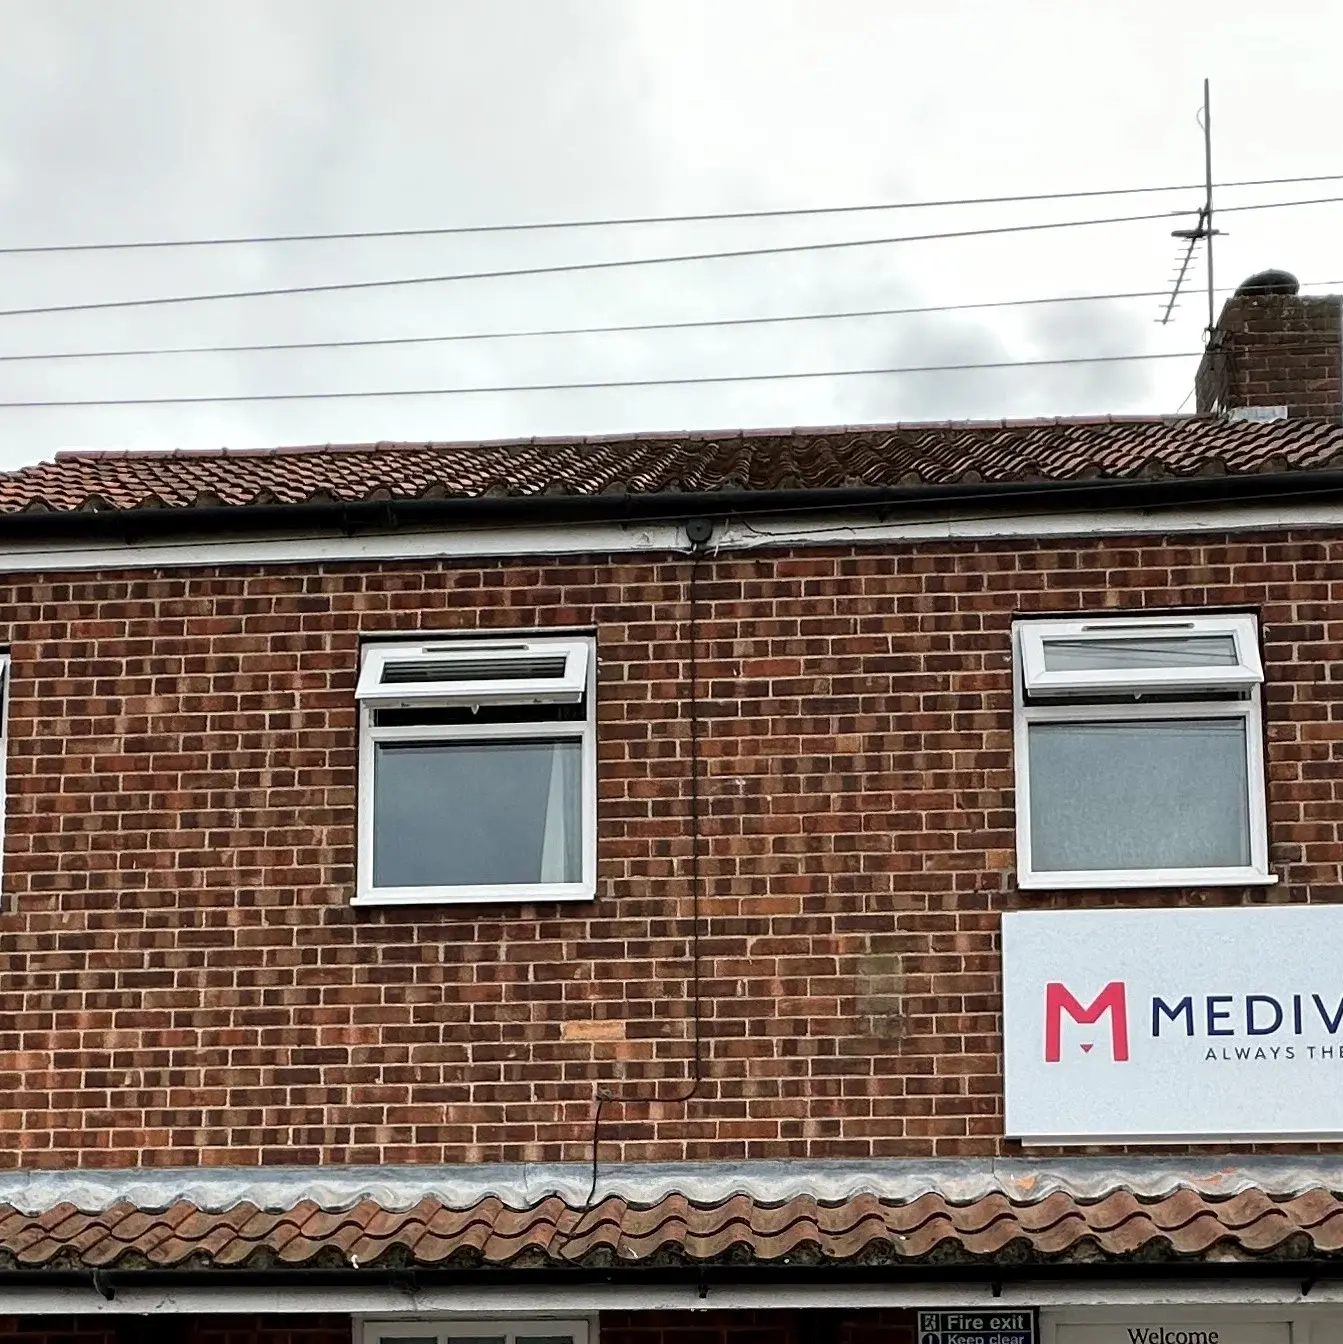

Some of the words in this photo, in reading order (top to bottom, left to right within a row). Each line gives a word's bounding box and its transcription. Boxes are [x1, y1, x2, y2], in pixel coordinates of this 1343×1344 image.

[1045, 981, 1130, 1062] M
[1204, 1046, 1296, 1061] ALWAYS
[947, 1314, 984, 1330] Fire
[989, 1314, 1024, 1330] exit
[1127, 1327, 1219, 1344] Welcome
